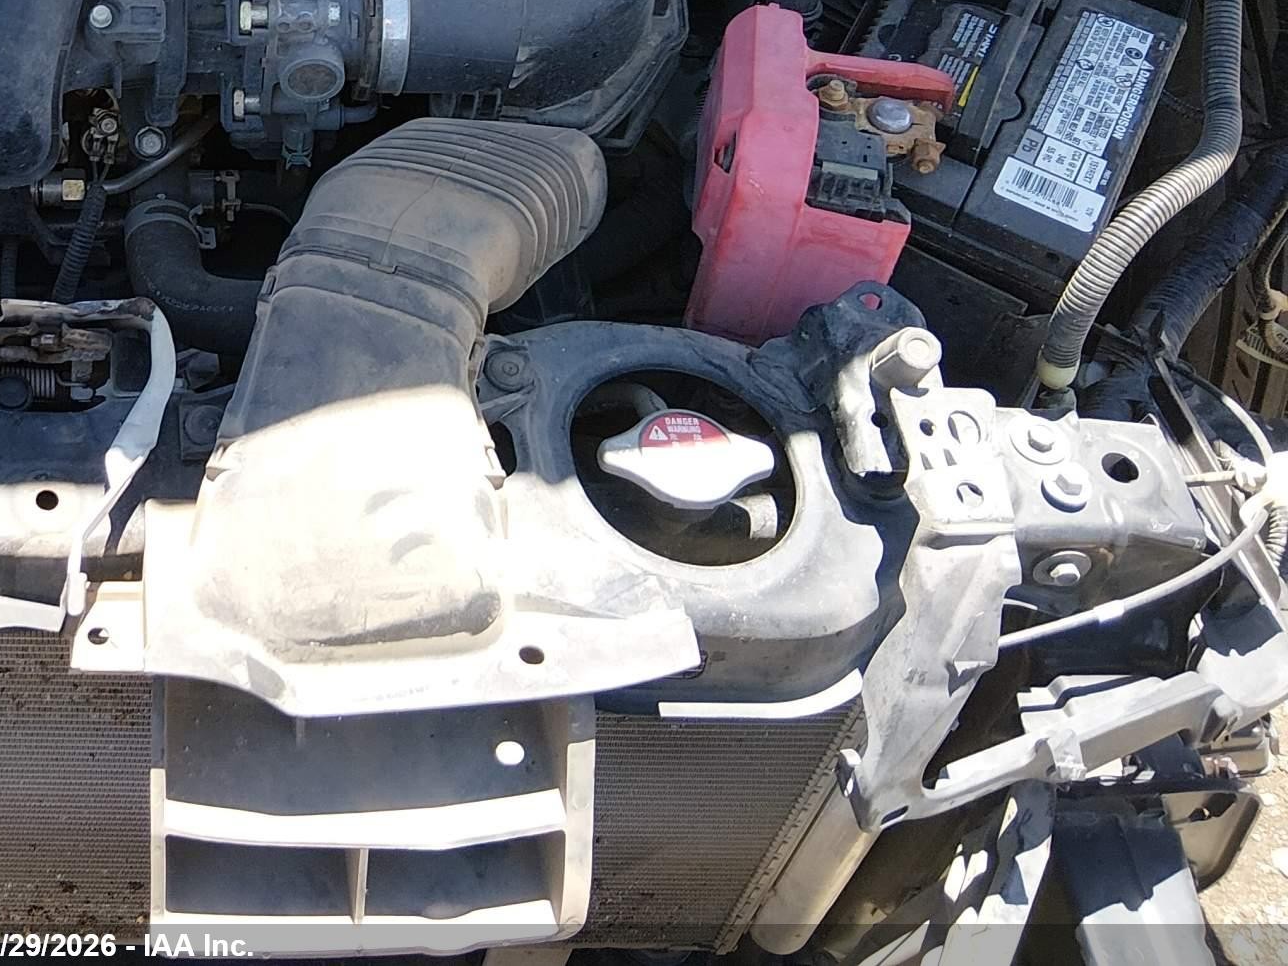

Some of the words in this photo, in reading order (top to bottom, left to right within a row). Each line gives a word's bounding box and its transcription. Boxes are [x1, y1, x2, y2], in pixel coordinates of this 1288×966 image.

[1113, 70, 1150, 140] DANGER/POISON
[1022, 138, 1038, 152] Pb
[664, 417, 700, 425] DANGER
